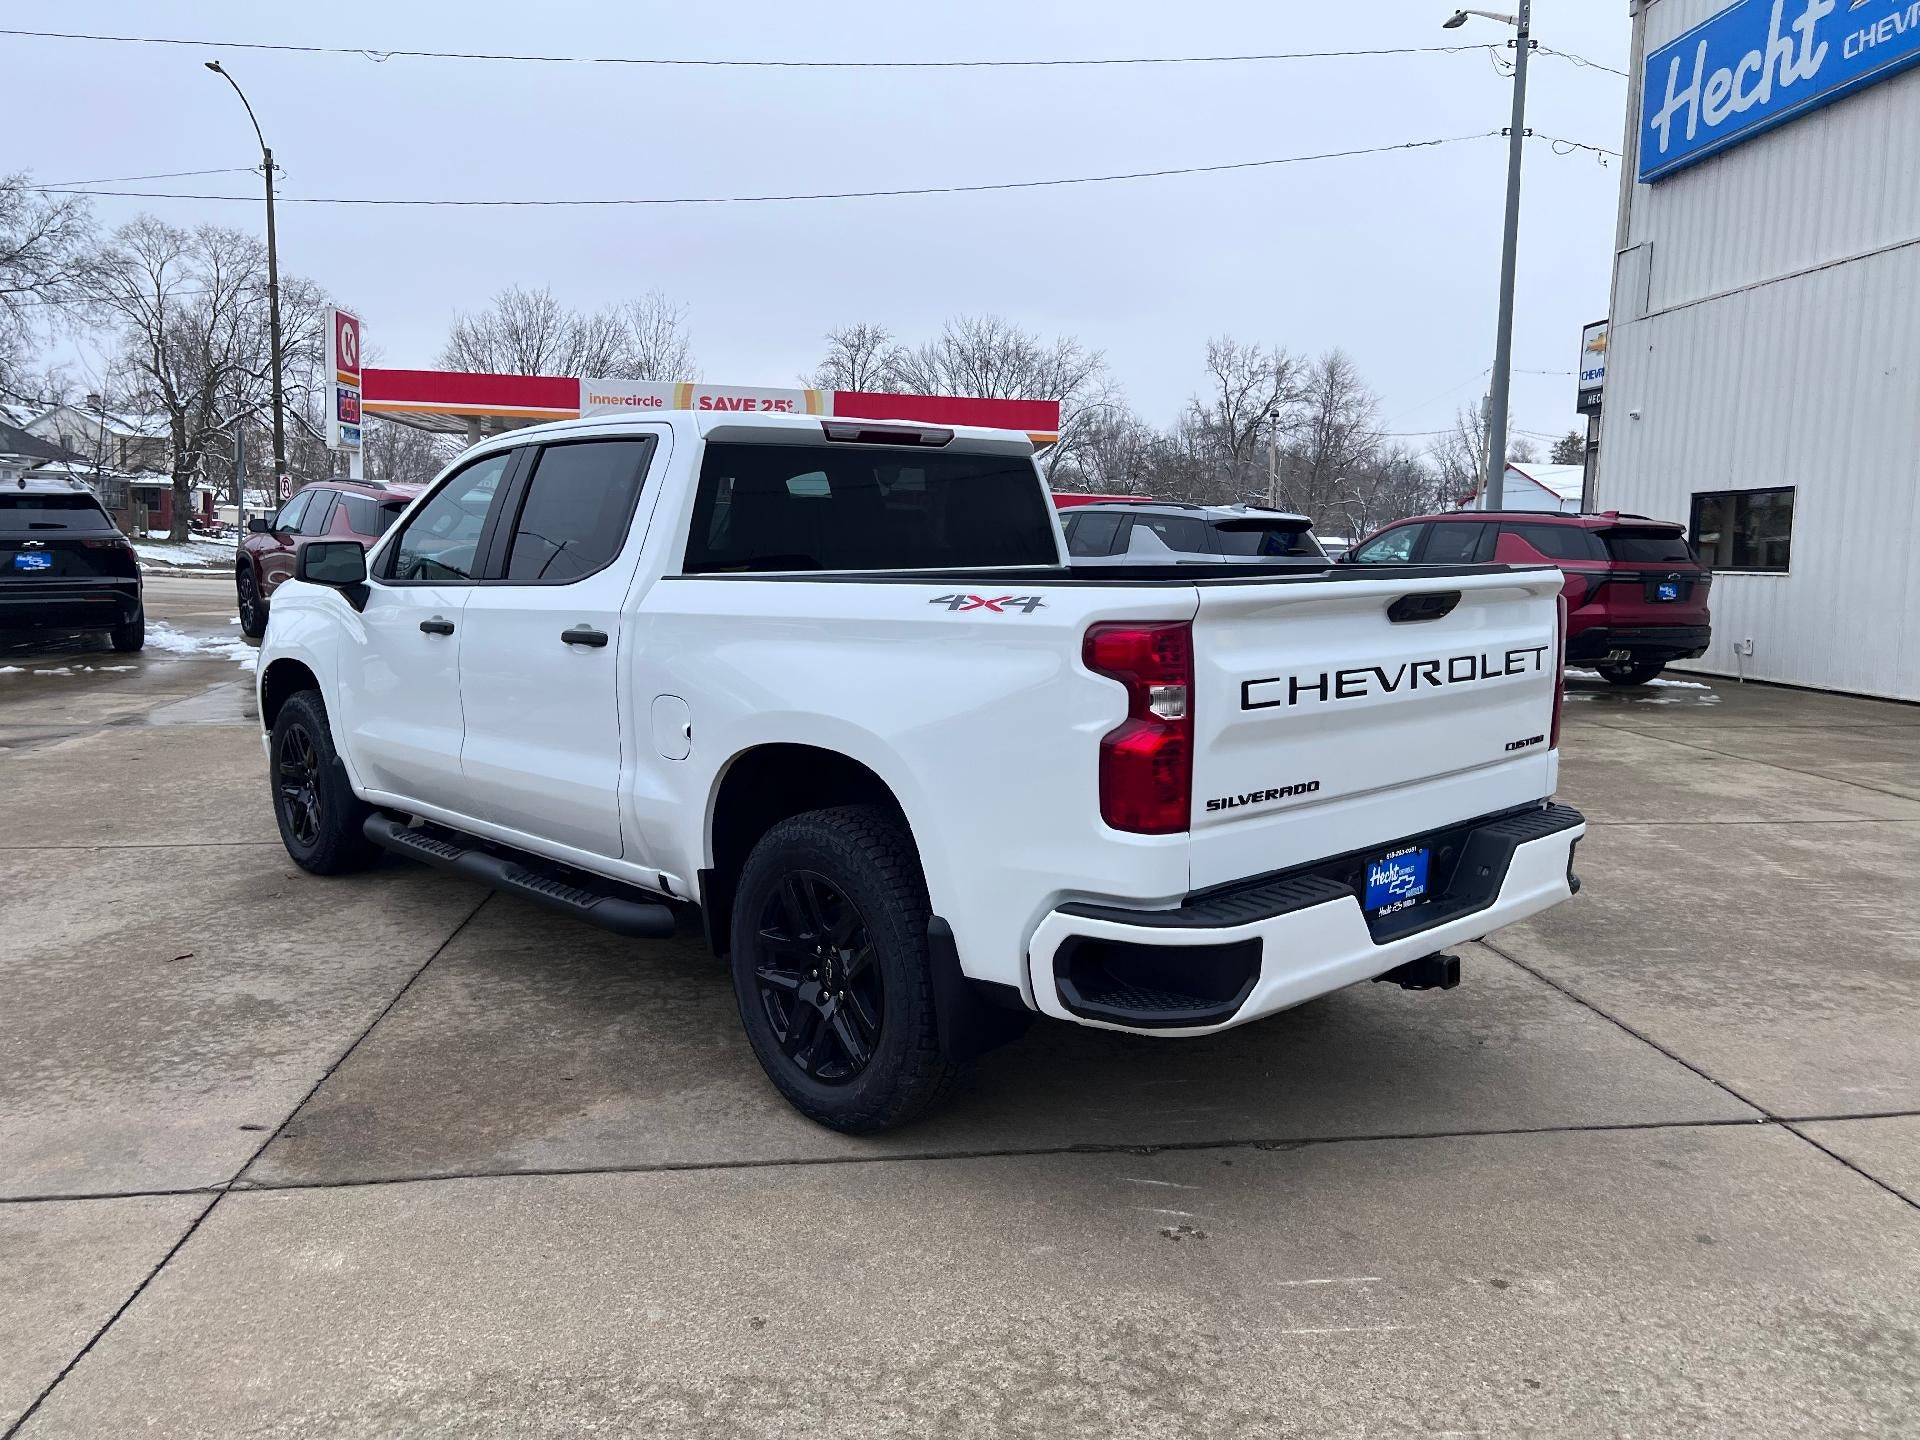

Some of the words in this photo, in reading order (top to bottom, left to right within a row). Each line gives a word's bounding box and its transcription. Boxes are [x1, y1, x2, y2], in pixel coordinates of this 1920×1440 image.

[1650, 0, 1835, 154] Hecht
[588, 392, 663, 408] innercircle
[698, 395, 757, 411] SAVE
[1240, 645, 1549, 711] CHEVROLET
[1505, 734, 1545, 751] CUSTOM
[1205, 780, 1320, 812] SILVERADO
[1369, 862, 1399, 888] Hecht
